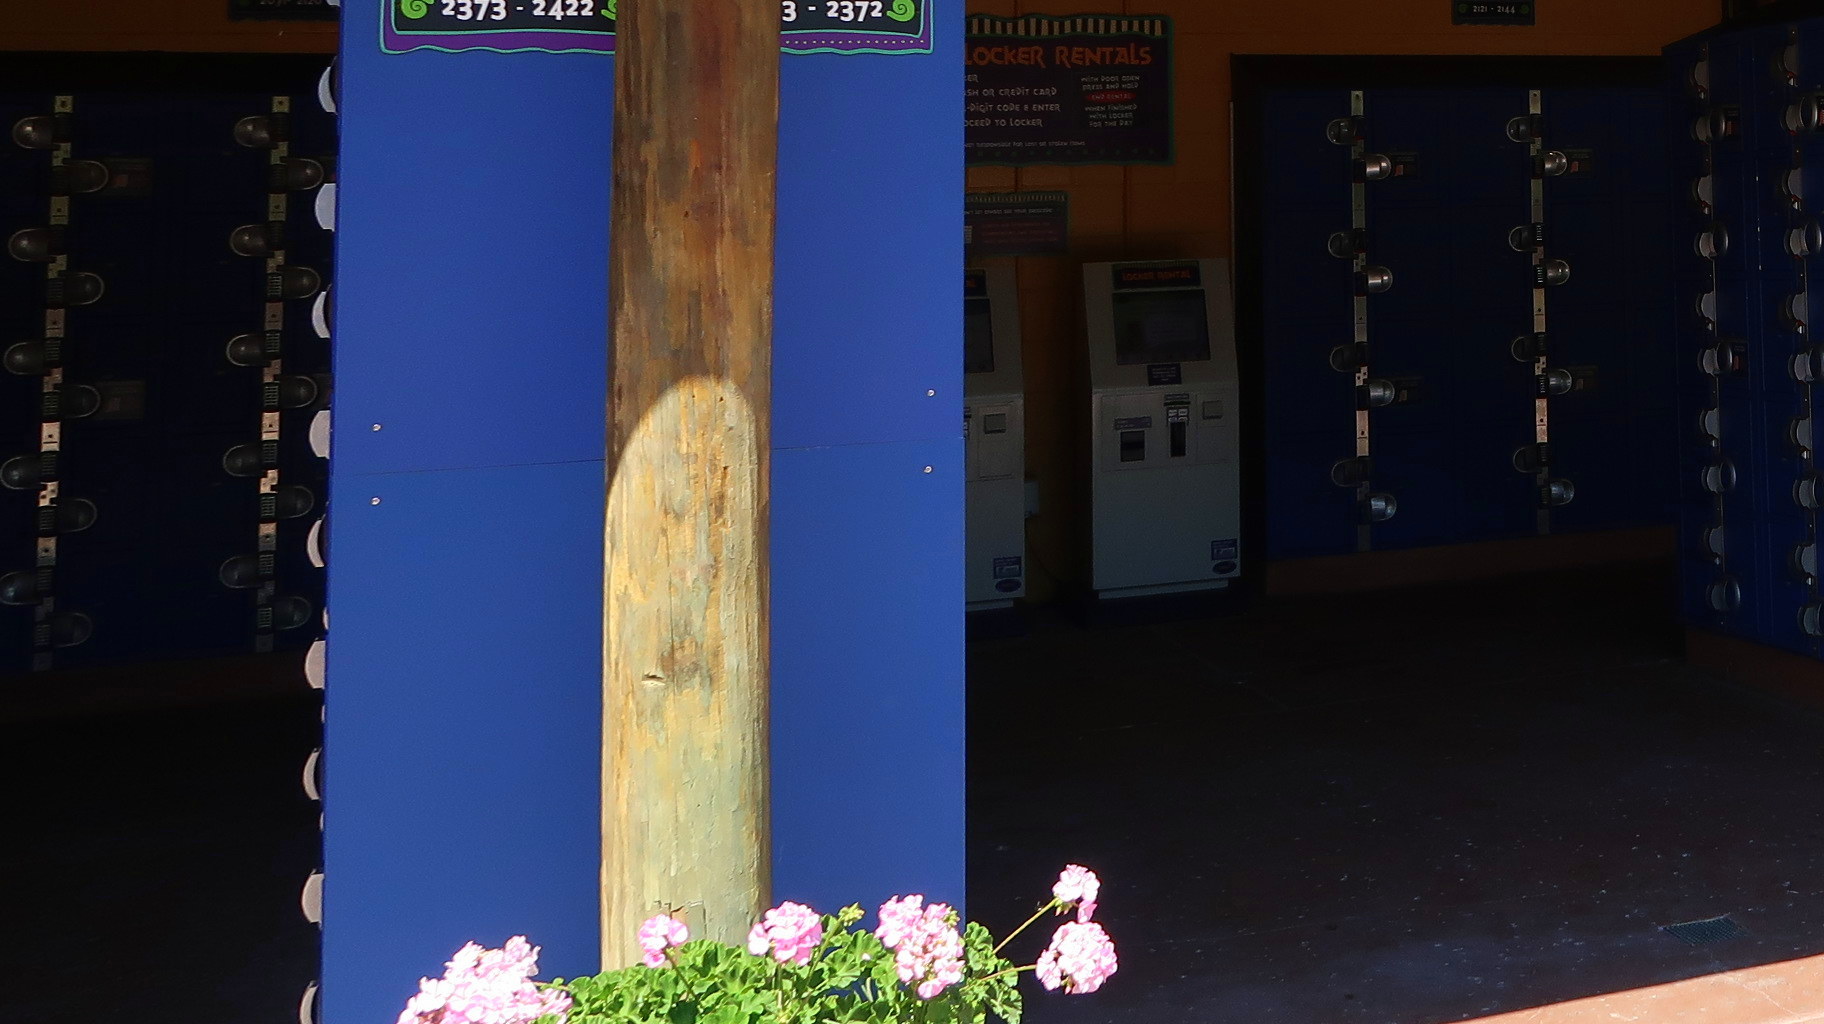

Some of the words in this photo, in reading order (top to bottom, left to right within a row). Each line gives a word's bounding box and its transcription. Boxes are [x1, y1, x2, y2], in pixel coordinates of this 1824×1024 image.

[826, 0, 883, 22] 2372
[966, 44, 1047, 69] LOCKER
[1055, 42, 1153, 69] RENTALS
[982, 88, 995, 97] OR
[1033, 86, 1057, 97] CARD
[996, 102, 1020, 112] CODE
[1032, 103, 1061, 112] ENTER
[995, 119, 1007, 127] TO
[1009, 117, 1043, 127] LOCKER
